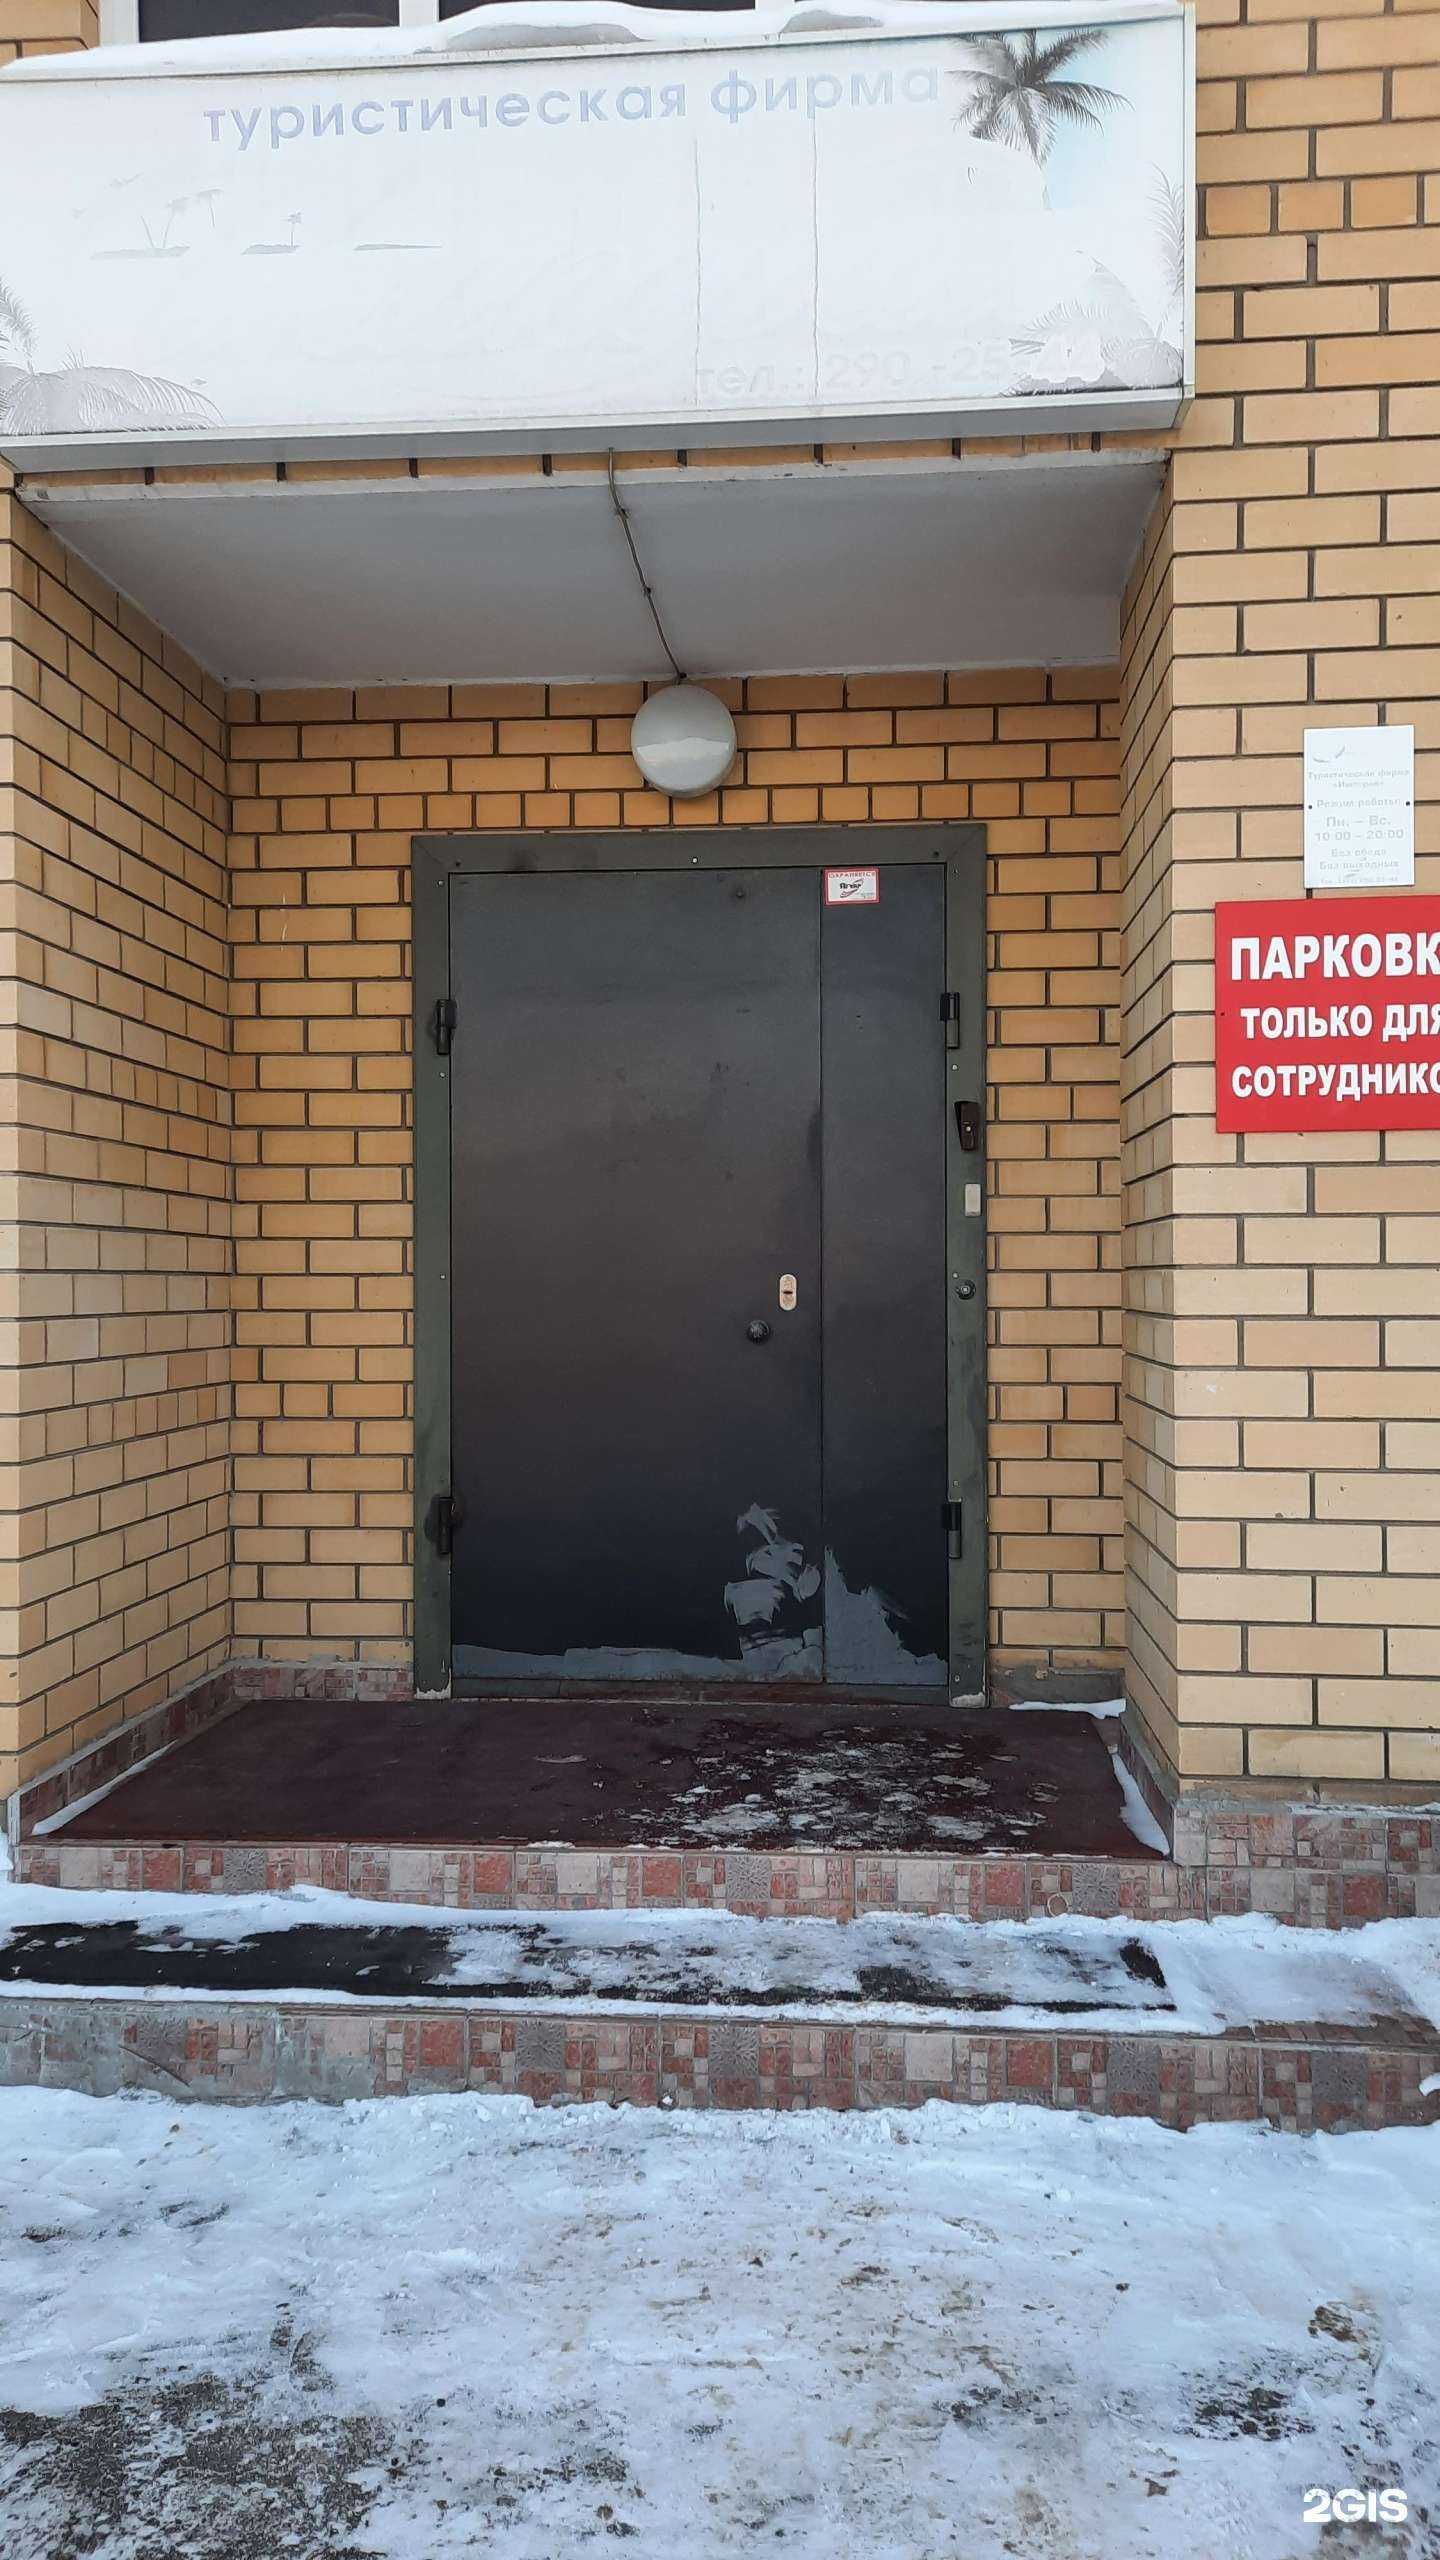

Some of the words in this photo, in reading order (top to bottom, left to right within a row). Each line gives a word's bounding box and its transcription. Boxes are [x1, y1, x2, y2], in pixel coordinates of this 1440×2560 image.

[202, 79, 687, 150] туристическая
[710, 66, 941, 124] фирма
[1326, 816, 1350, 828] Пн.
[1369, 815, 1391, 826] Вс.
[1366, 829, 1404, 840] 20:00
[1231, 932, 1440, 981] ПАРКОВК
[1240, 1004, 1373, 1040] ТОЛЬКО
